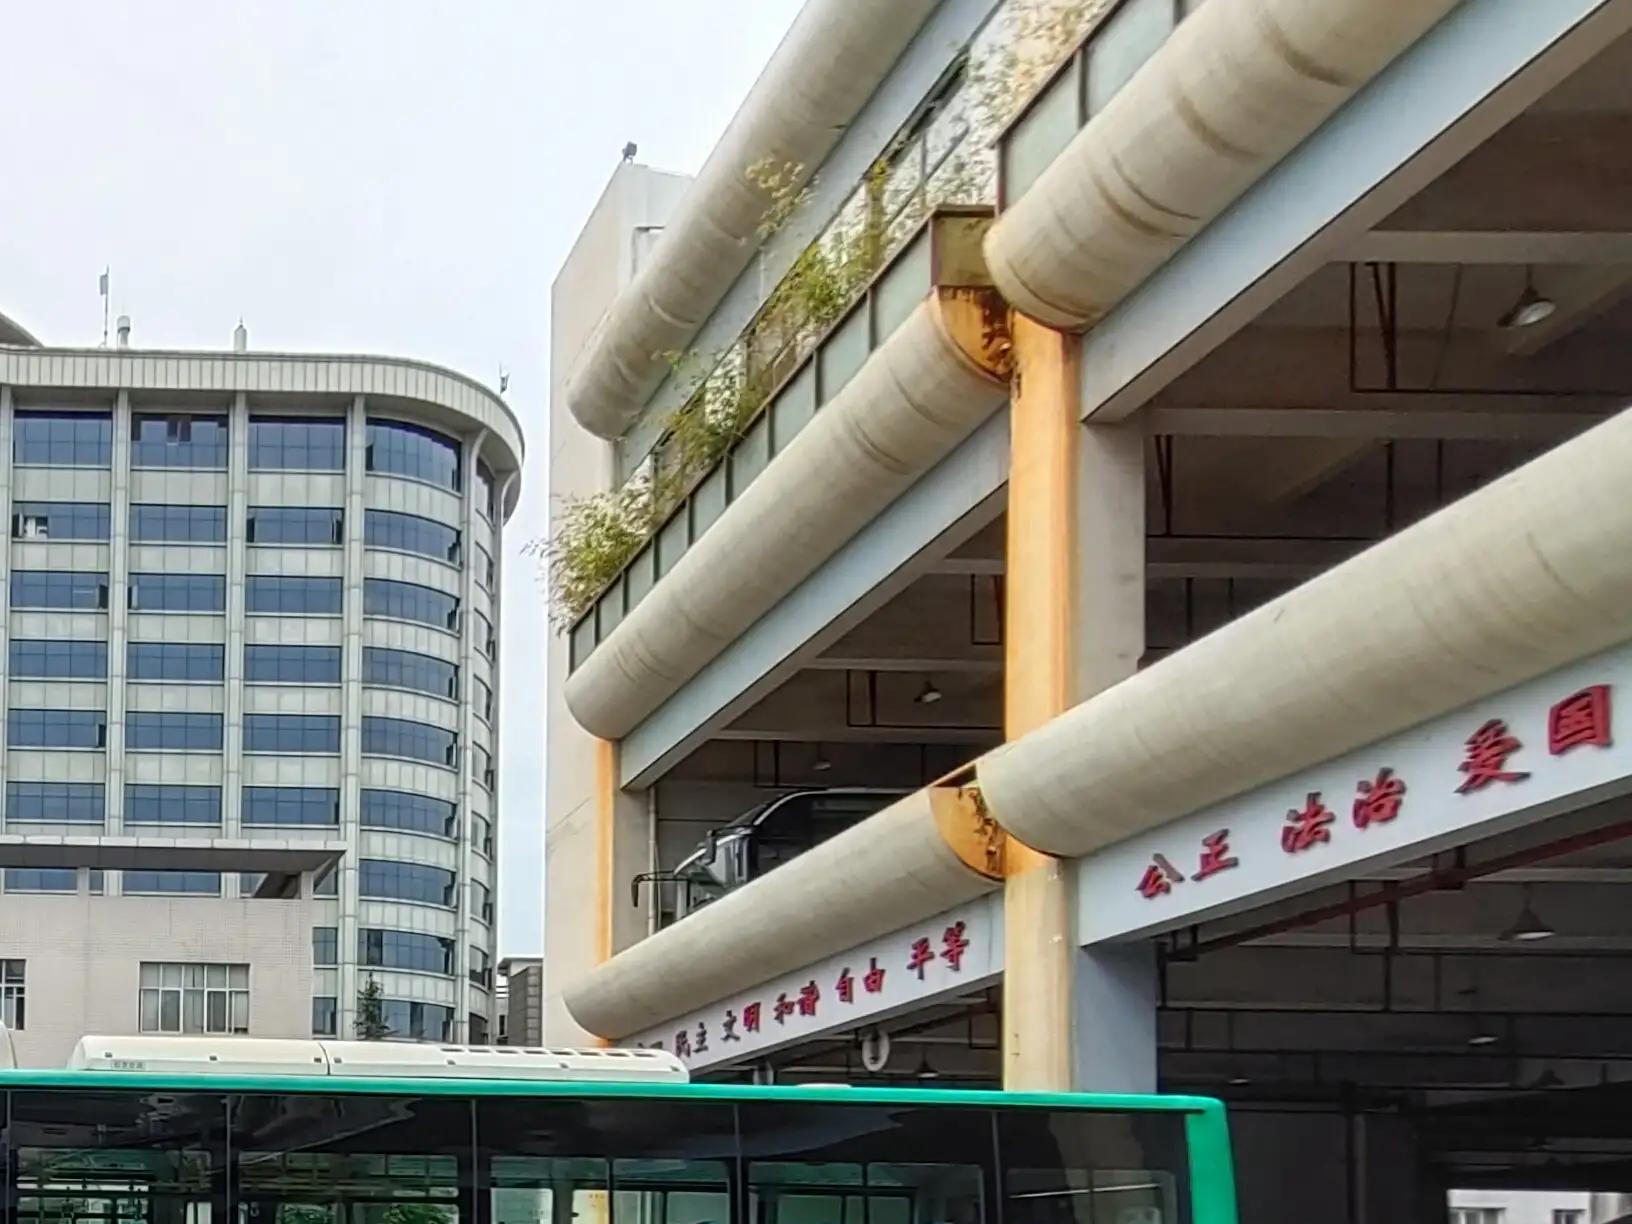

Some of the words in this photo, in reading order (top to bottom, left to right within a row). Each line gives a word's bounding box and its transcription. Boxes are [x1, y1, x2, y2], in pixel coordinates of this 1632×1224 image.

[1136, 828, 1239, 899] 公正
[1280, 766, 1407, 854] 法治
[1454, 683, 1614, 795] 爱国
[675, 1021, 708, 1057] 民主
[720, 1002, 761, 1043] 文明
[773, 980, 820, 1025] 和谐
[835, 957, 886, 1004] 自由
[907, 921, 970, 981] 平等
